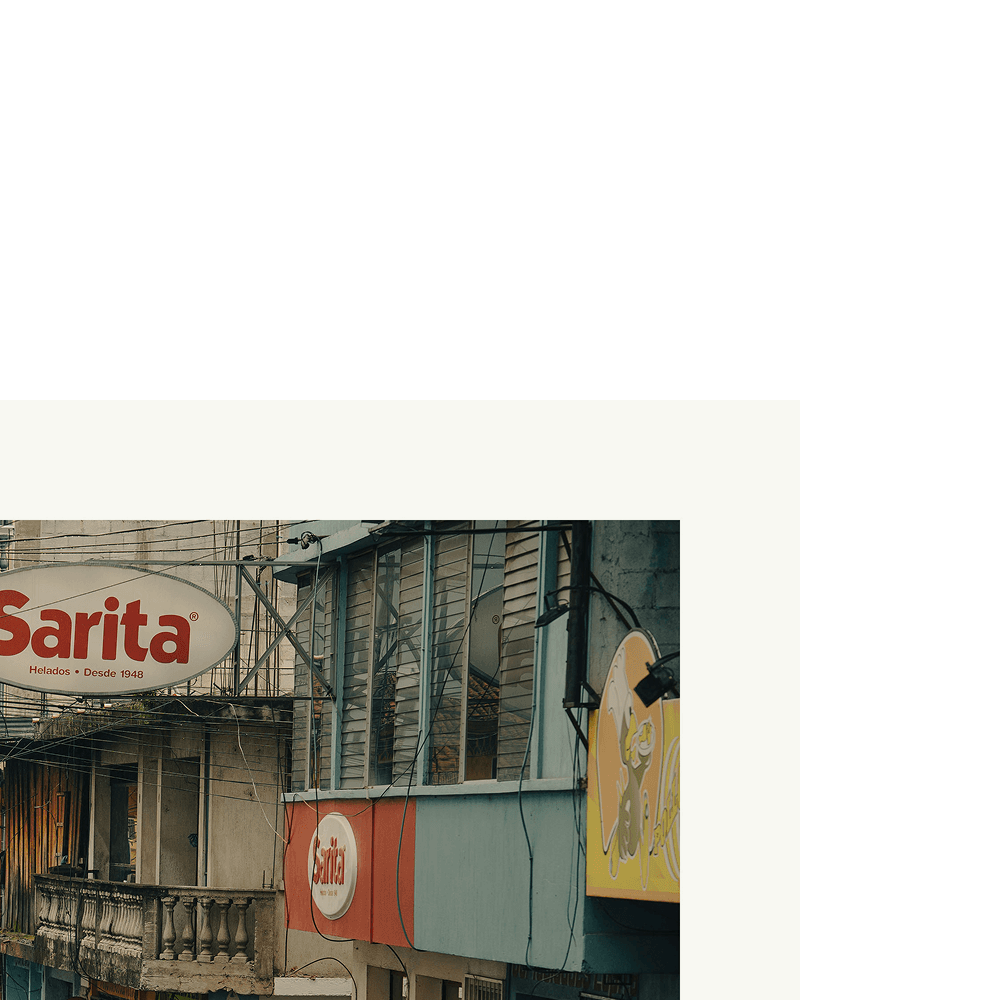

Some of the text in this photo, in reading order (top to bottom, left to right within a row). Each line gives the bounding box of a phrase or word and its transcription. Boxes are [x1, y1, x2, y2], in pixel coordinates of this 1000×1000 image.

[29, 665, 144, 679] Helados Desde 1948
[312, 836, 346, 885] Sarita
